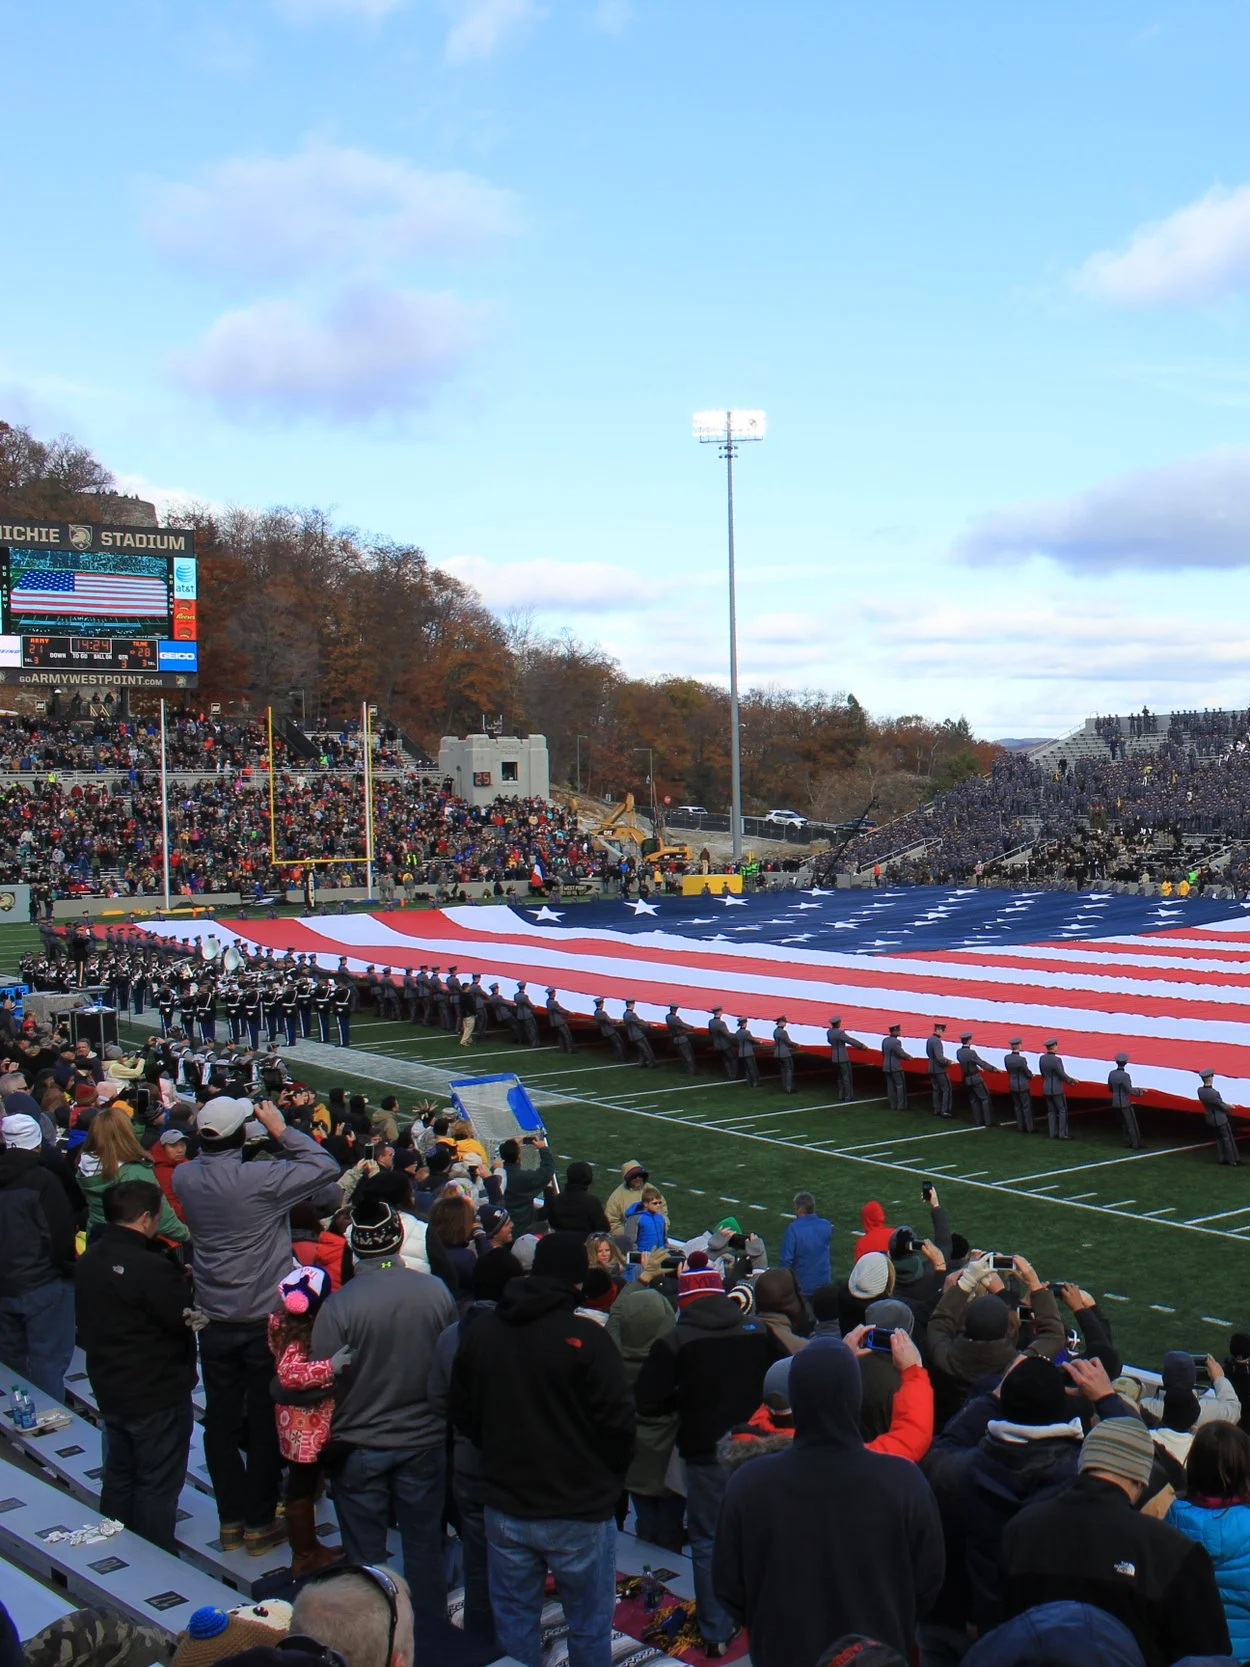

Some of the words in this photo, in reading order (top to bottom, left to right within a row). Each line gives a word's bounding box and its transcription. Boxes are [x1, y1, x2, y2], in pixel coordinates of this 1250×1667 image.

[0, 525, 60, 543] ICHIE
[101, 531, 185, 551] STADIUM
[175, 585, 195, 594] at&t
[29, 644, 44, 654] 21
[76, 639, 110, 651] 14:24
[137, 647, 151, 657] 28
[159, 652, 196, 660] GEICO
[33, 656, 40, 665] 3
[121, 660, 128, 669] 3
[142, 659, 148, 668] 3
[475, 772, 490, 785] 25
